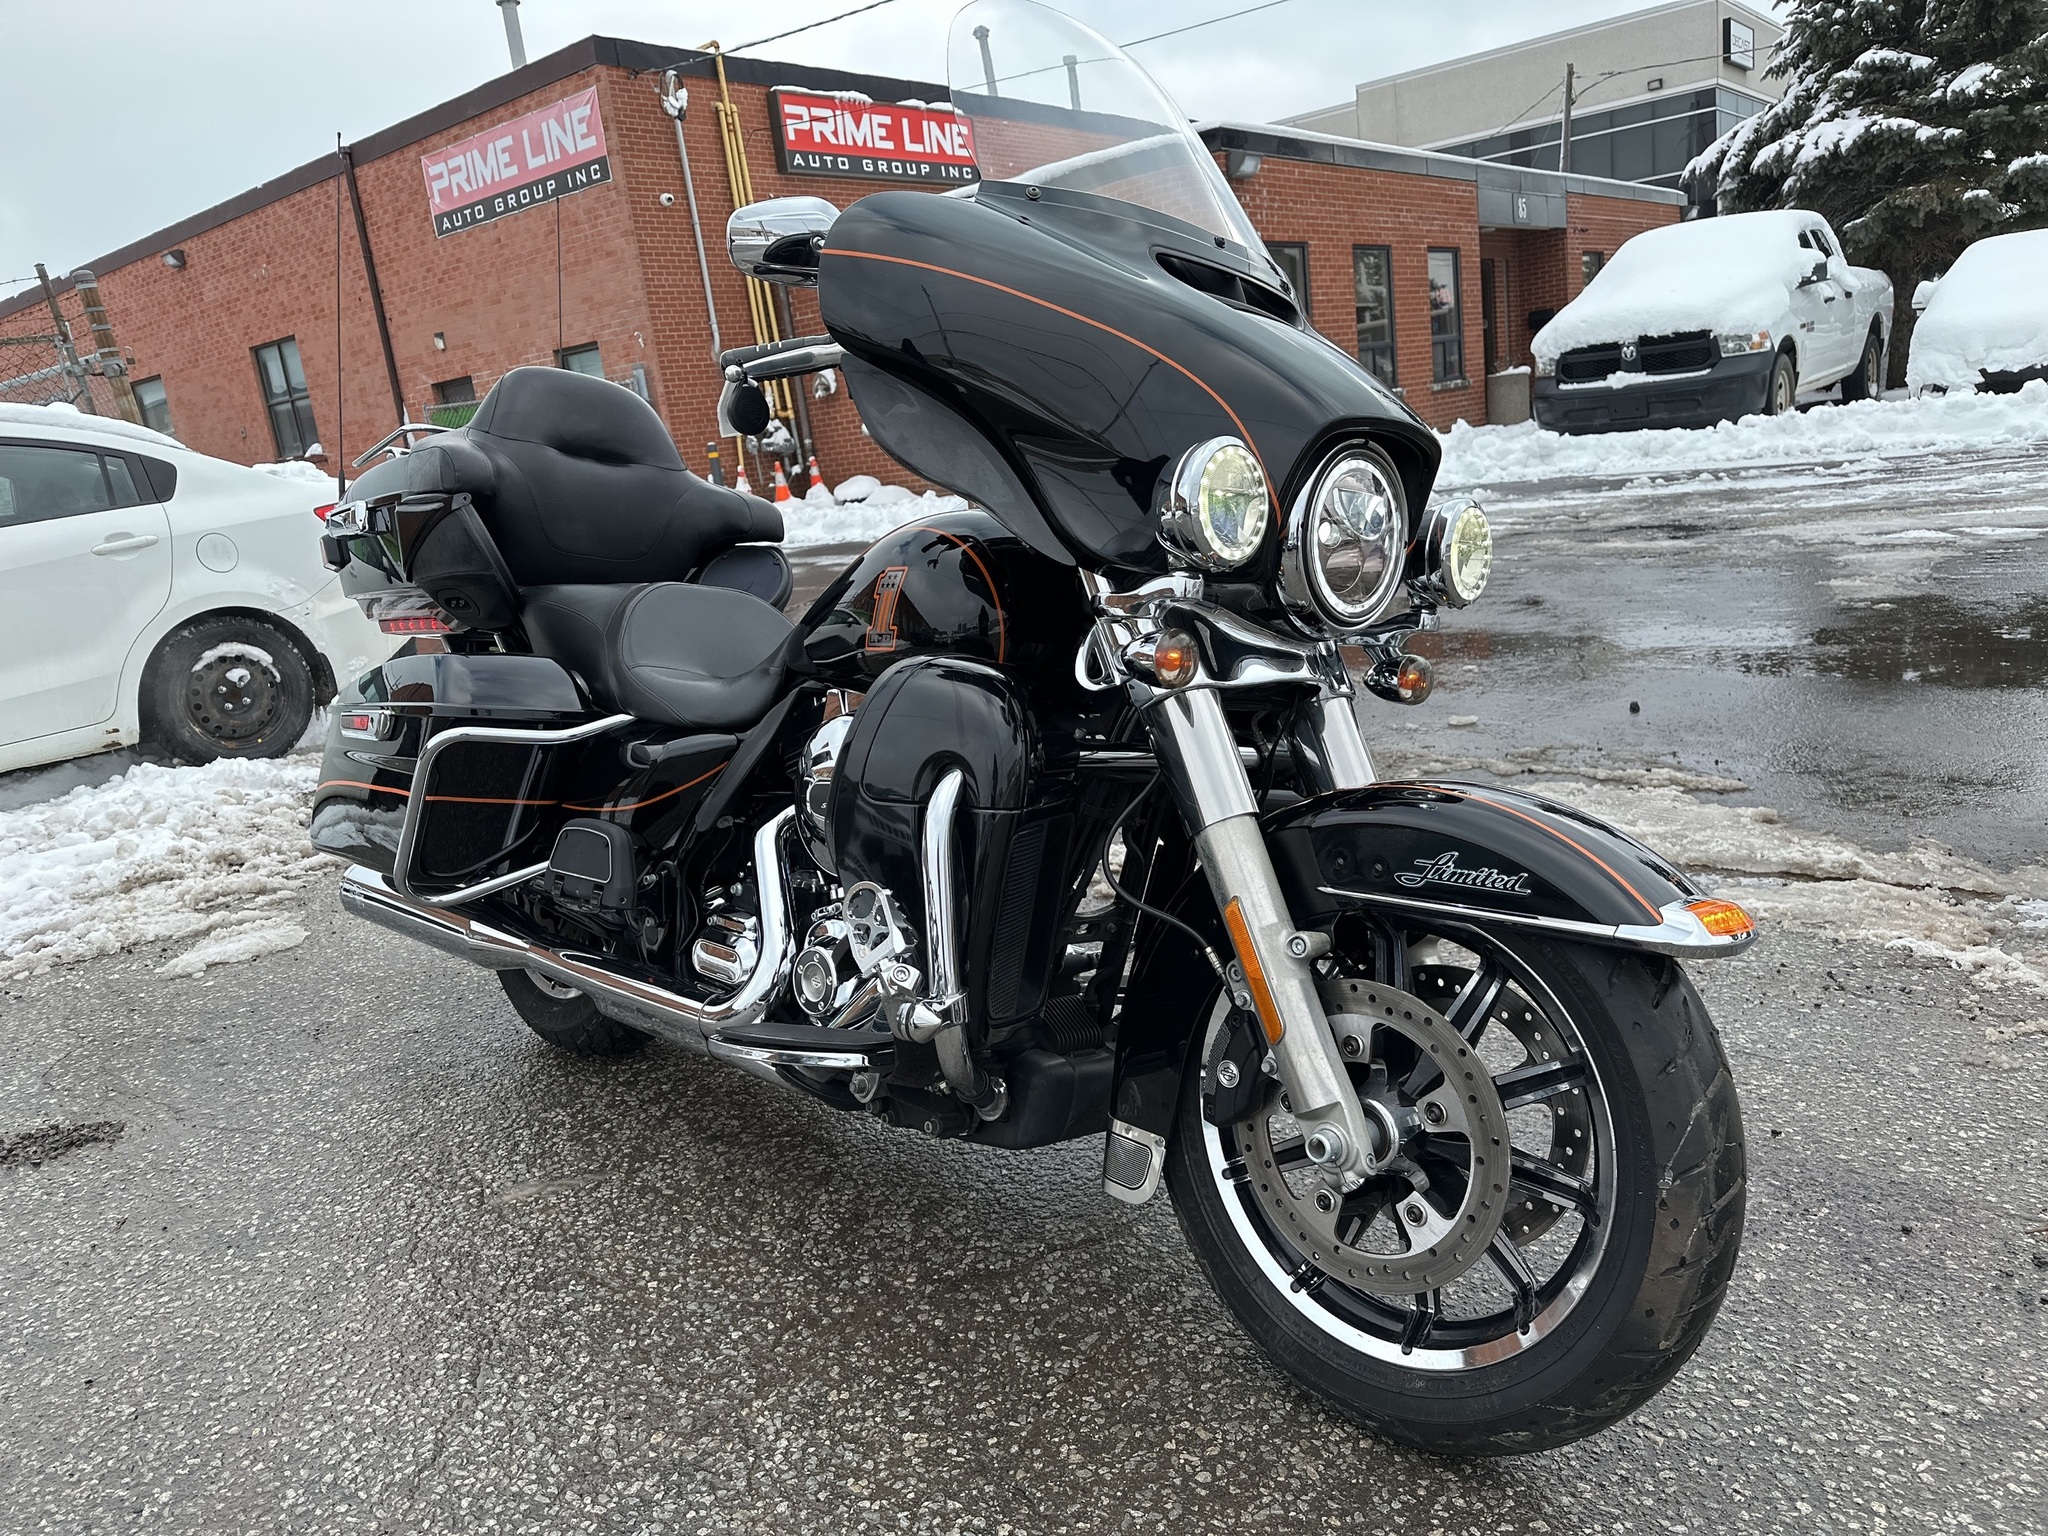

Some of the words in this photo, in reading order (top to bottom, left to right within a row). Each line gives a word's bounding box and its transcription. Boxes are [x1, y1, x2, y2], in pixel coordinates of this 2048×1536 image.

[428, 134, 519, 203] PRIME
[522, 103, 597, 170] LINE
[783, 104, 895, 150] PRIME
[901, 117, 970, 158] LINE
[793, 153, 849, 170] AUTO
[862, 158, 930, 176] GROUP
[941, 165, 973, 179] INC
[442, 205, 484, 231] AUTO
[494, 179, 556, 212] GROUP
[566, 164, 601, 188] INC
[1393, 851, 1532, 896] Limited
